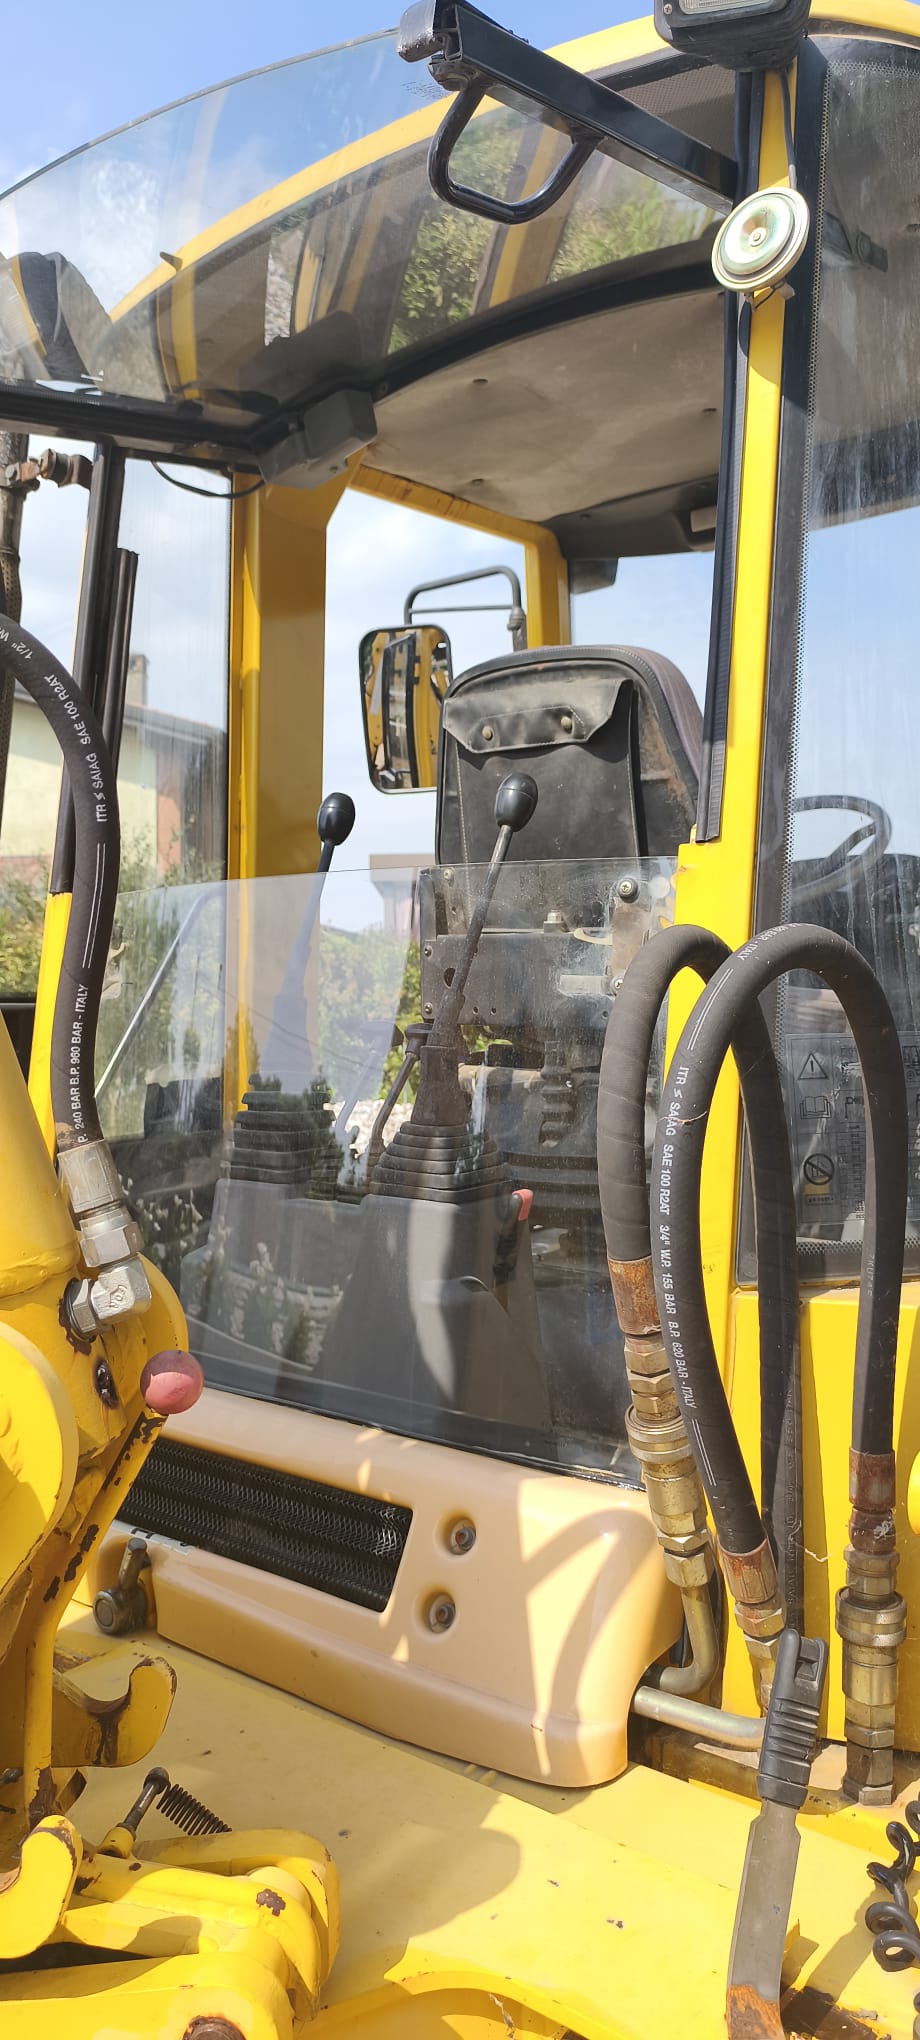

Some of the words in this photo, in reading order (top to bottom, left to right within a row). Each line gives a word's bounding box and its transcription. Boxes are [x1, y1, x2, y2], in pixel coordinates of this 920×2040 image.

[11, 642, 33, 659] 1/2"
[44, 674, 70, 701] R2AT
[63, 701, 80, 720] 100
[73, 720, 91, 745] SAE
[85, 752, 104, 789] SAIAG
[96, 803, 107, 822] ITR
[736, 943, 758, 960] ITALY
[75, 983, 89, 1012] ITALY
[71, 1021, 83, 1044] BAR
[70, 1046, 81, 1065] 960
[69, 1066, 80, 1085] B.P.
[675, 1066, 689, 1085] ITR
[70, 1087, 81, 1110] BAR
[72, 1111, 85, 1130] 240
[662, 1144, 674, 1167] SAE
[660, 1168, 672, 1186] 100
[660, 1188, 670, 1216] R2AT
[660, 1224, 670, 1245] 3/4"
[660, 1249, 672, 1268] W.P.
[662, 1273, 673, 1289] 155
[664, 1293, 676, 1314] BAR
[668, 1321, 680, 1337] B.P.
[671, 1342, 685, 1358] 620
[675, 1359, 689, 1378] BAR
[681, 1385, 697, 1409] ITALY
